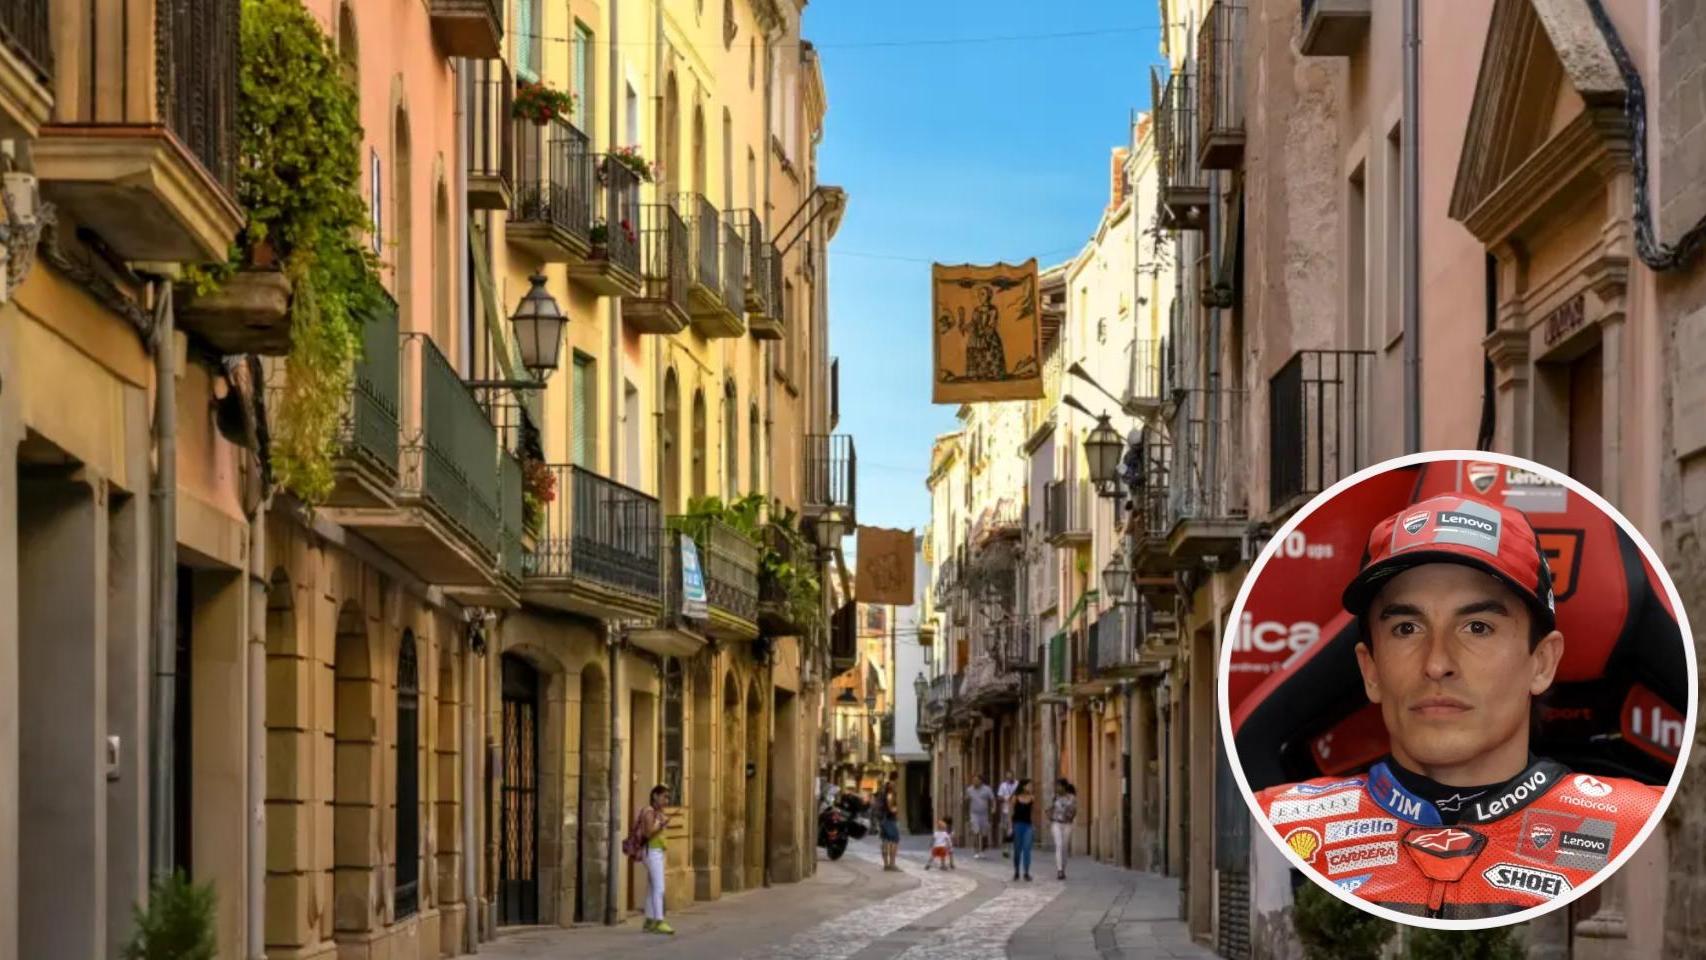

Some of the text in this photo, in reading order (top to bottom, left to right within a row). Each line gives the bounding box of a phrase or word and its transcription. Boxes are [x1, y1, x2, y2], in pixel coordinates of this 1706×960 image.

[1505, 468, 1562, 486] Lenov
[1441, 513, 1493, 531] Lenovo
[1388, 789, 1422, 820] TIM
[1476, 771, 1546, 821] Lenovo
[1559, 794, 1618, 813] motorola
[1345, 820, 1393, 836] riello
[1563, 834, 1605, 850] Lenovo
[1330, 847, 1395, 866] CARRERA
[1497, 869, 1562, 896] SHOEI
